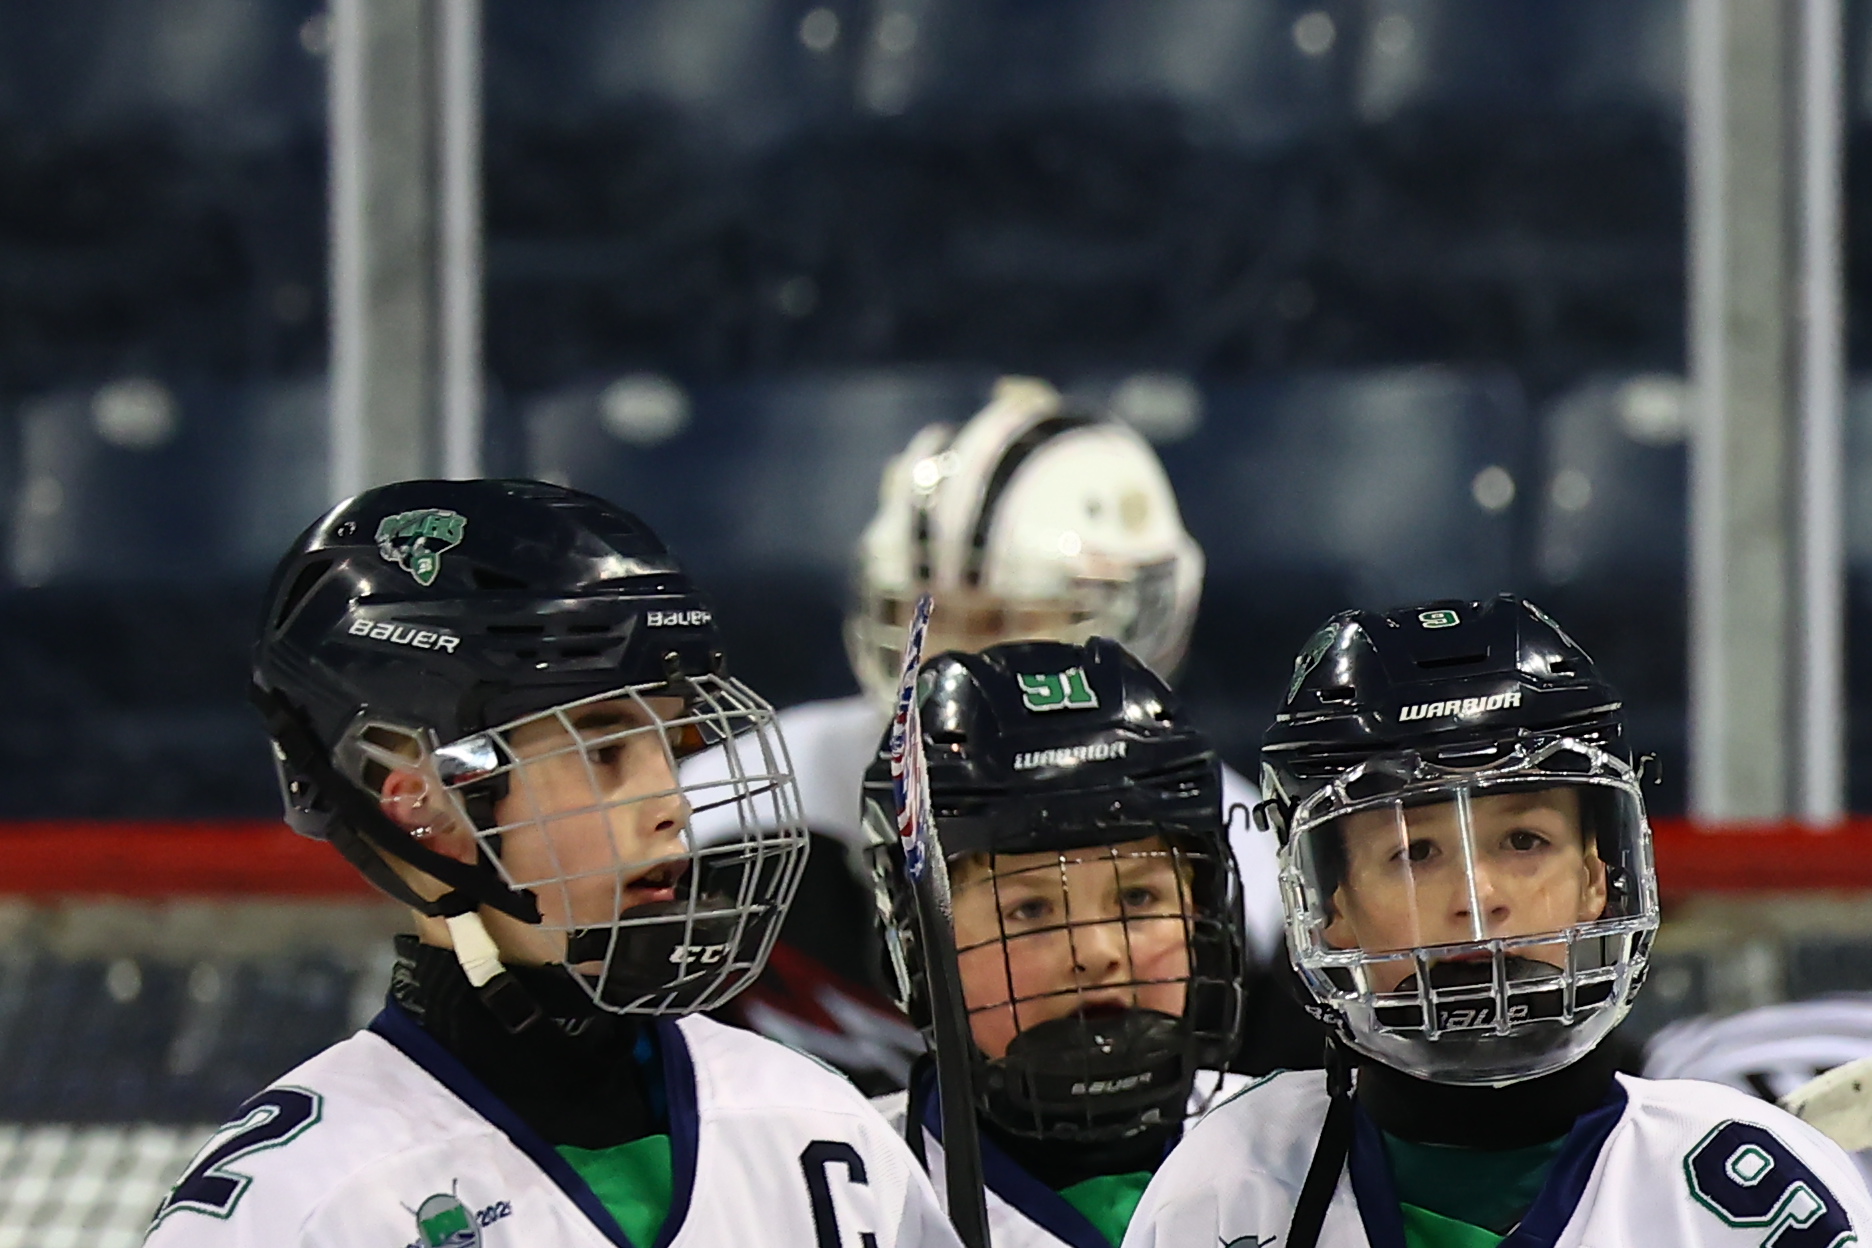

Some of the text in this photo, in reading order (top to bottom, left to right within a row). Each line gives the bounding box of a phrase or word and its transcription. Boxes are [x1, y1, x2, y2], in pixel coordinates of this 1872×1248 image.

[1418, 609, 1460, 629] 9
[1017, 666, 1099, 712] 91
[1399, 692, 1521, 722] WARRIOR
[1013, 741, 1126, 770] WARRIOR
[668, 943, 732, 964] CC
